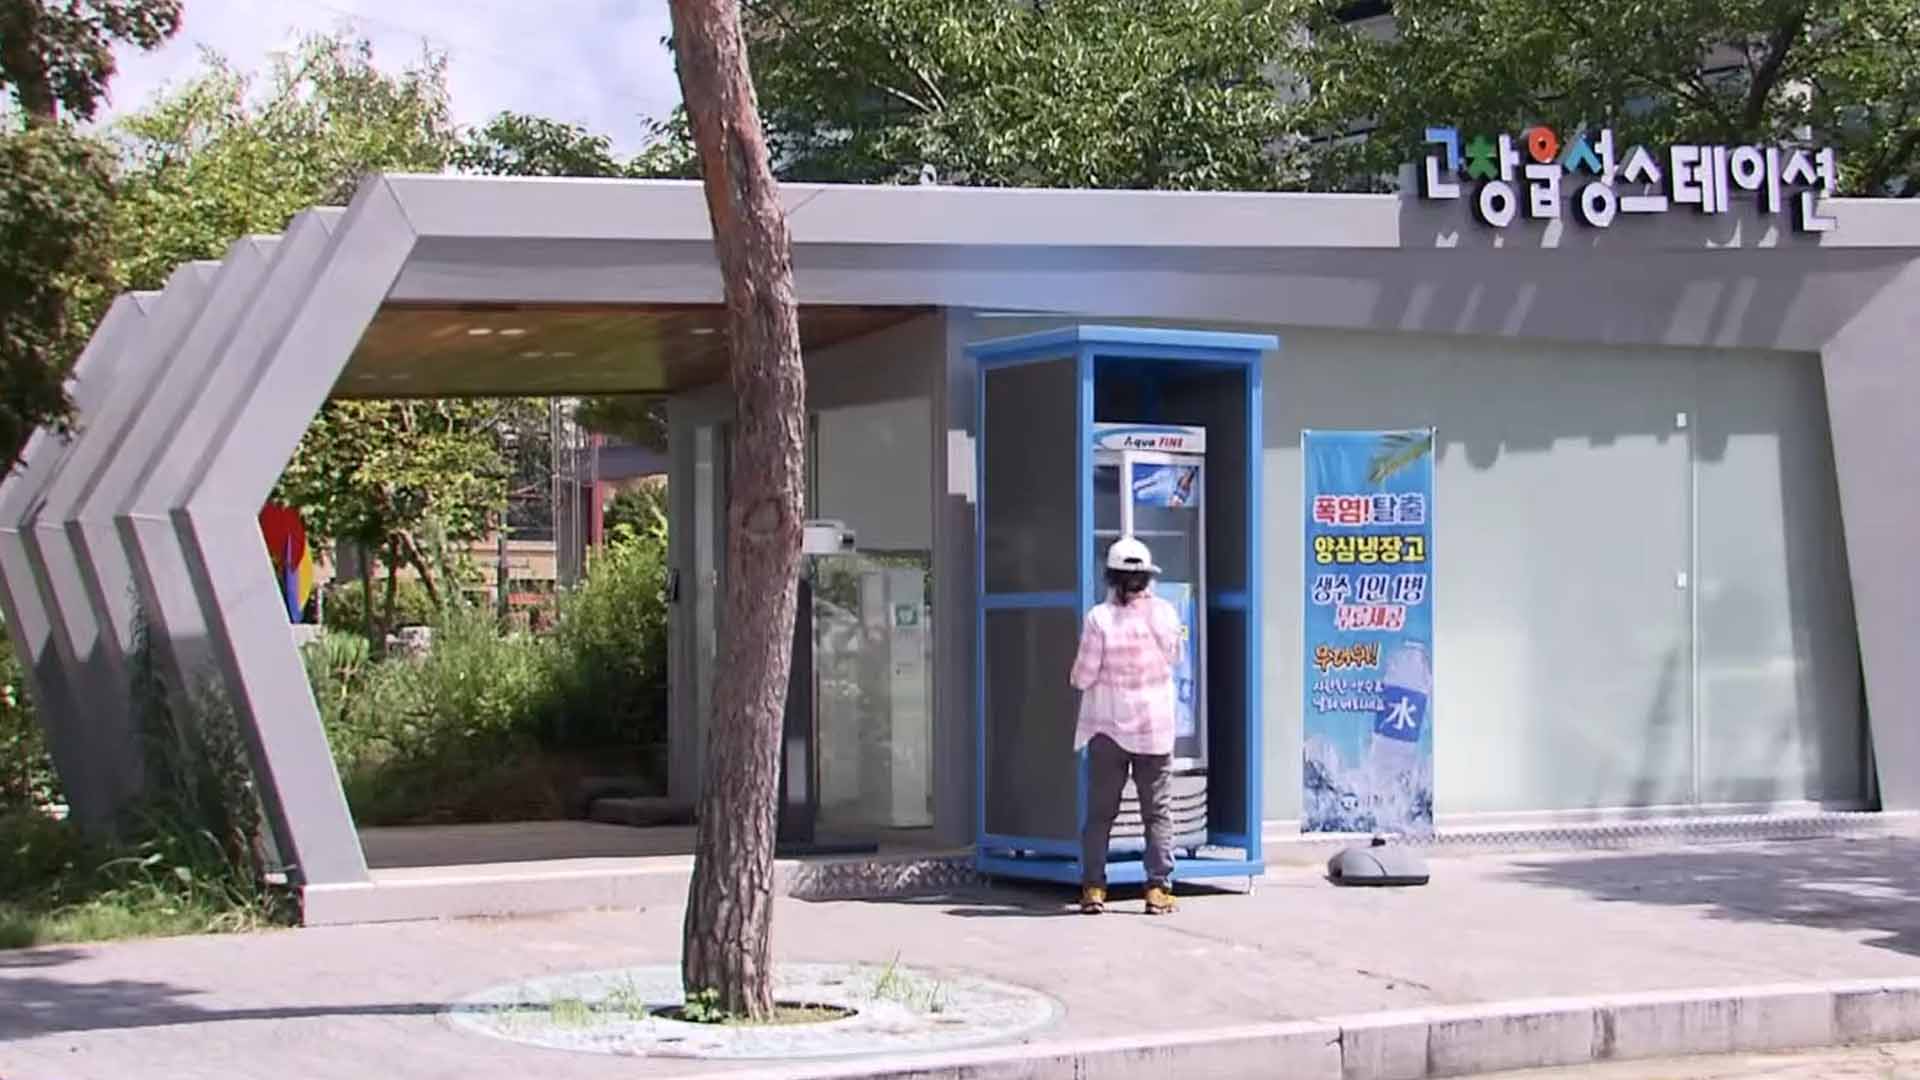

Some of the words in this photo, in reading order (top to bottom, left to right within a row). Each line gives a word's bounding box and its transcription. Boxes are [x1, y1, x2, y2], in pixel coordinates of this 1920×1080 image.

[1424, 126, 1837, 234] 고창읍성스테이션
[1123, 436, 1155, 449] Aqua
[1158, 437, 1185, 449] FINE
[1314, 536, 1425, 564] 양심냉장고
[1314, 576, 1350, 603] 생수
[1357, 576, 1388, 602] 1인
[1394, 576, 1424, 602] 1병
[1336, 606, 1405, 629] 무료제공
[1385, 696, 1417, 730] 水
